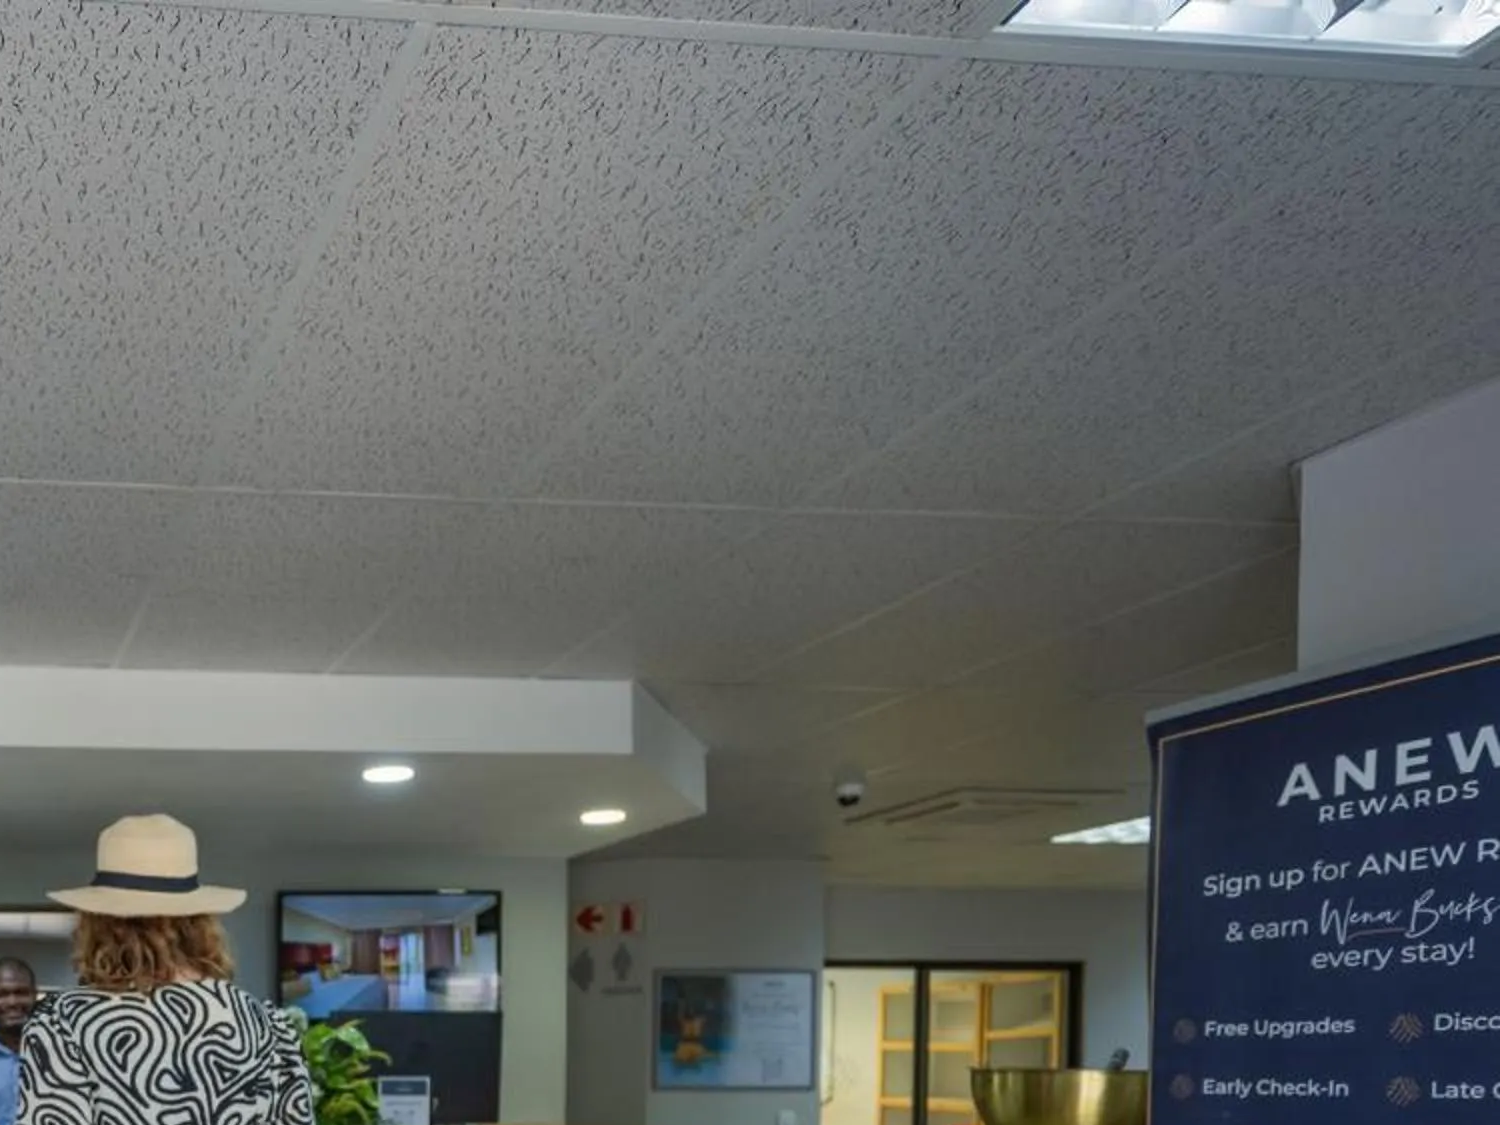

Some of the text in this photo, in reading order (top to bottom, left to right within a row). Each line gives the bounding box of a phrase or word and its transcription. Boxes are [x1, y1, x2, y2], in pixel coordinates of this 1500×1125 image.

[1276, 725, 1500, 807] ANEW
[1318, 780, 1480, 823] REWARDS
[1203, 872, 1261, 898] Sign
[1269, 870, 1304, 890] up
[1313, 858, 1351, 882] for
[1358, 842, 1466, 878] ANEW
[1225, 921, 1243, 942] &
[1250, 917, 1308, 940] earn
[1311, 936, 1475, 971] every stay!
[1204, 1016, 1356, 1040] Free Upgrades
[1203, 1077, 1349, 1098] Early Check-In
[1431, 1080, 1485, 1099] Late
